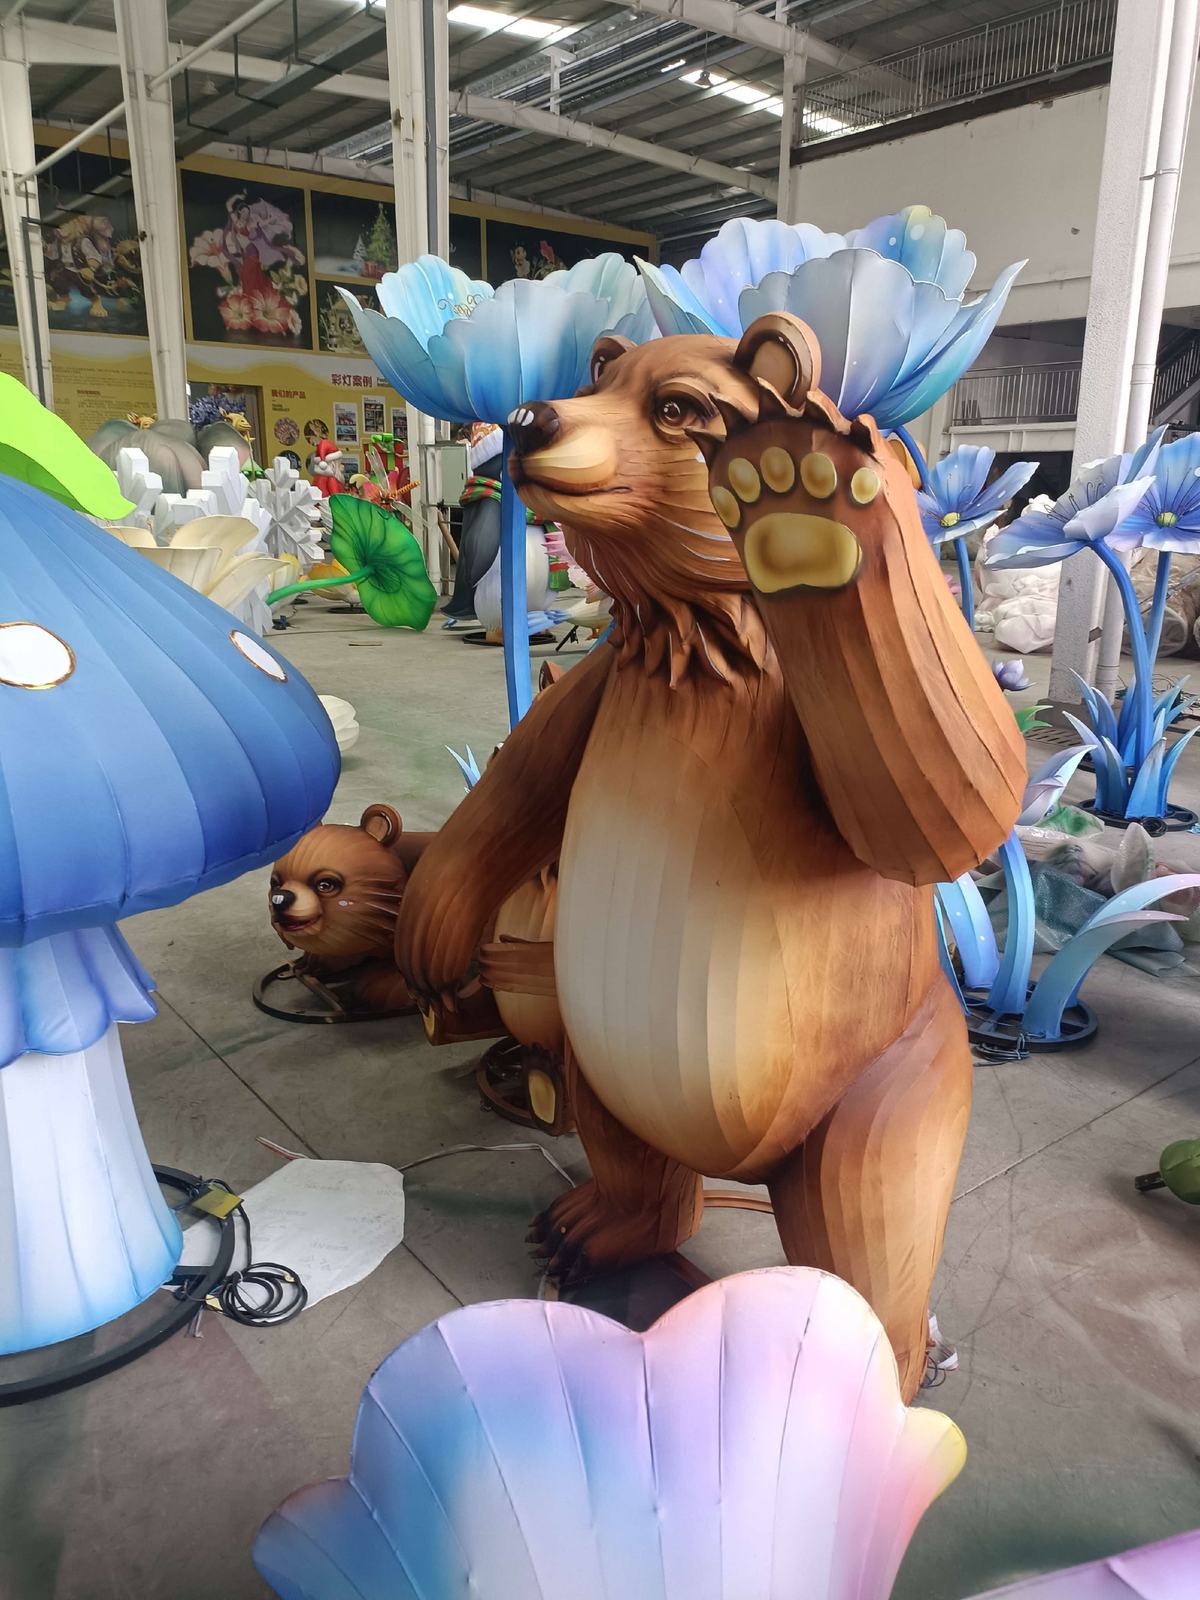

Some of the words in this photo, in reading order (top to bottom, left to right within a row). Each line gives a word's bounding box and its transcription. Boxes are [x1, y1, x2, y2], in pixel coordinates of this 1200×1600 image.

[331, 373, 373, 388] 彩灯案例
[271, 389, 306, 399] 我们的产品
